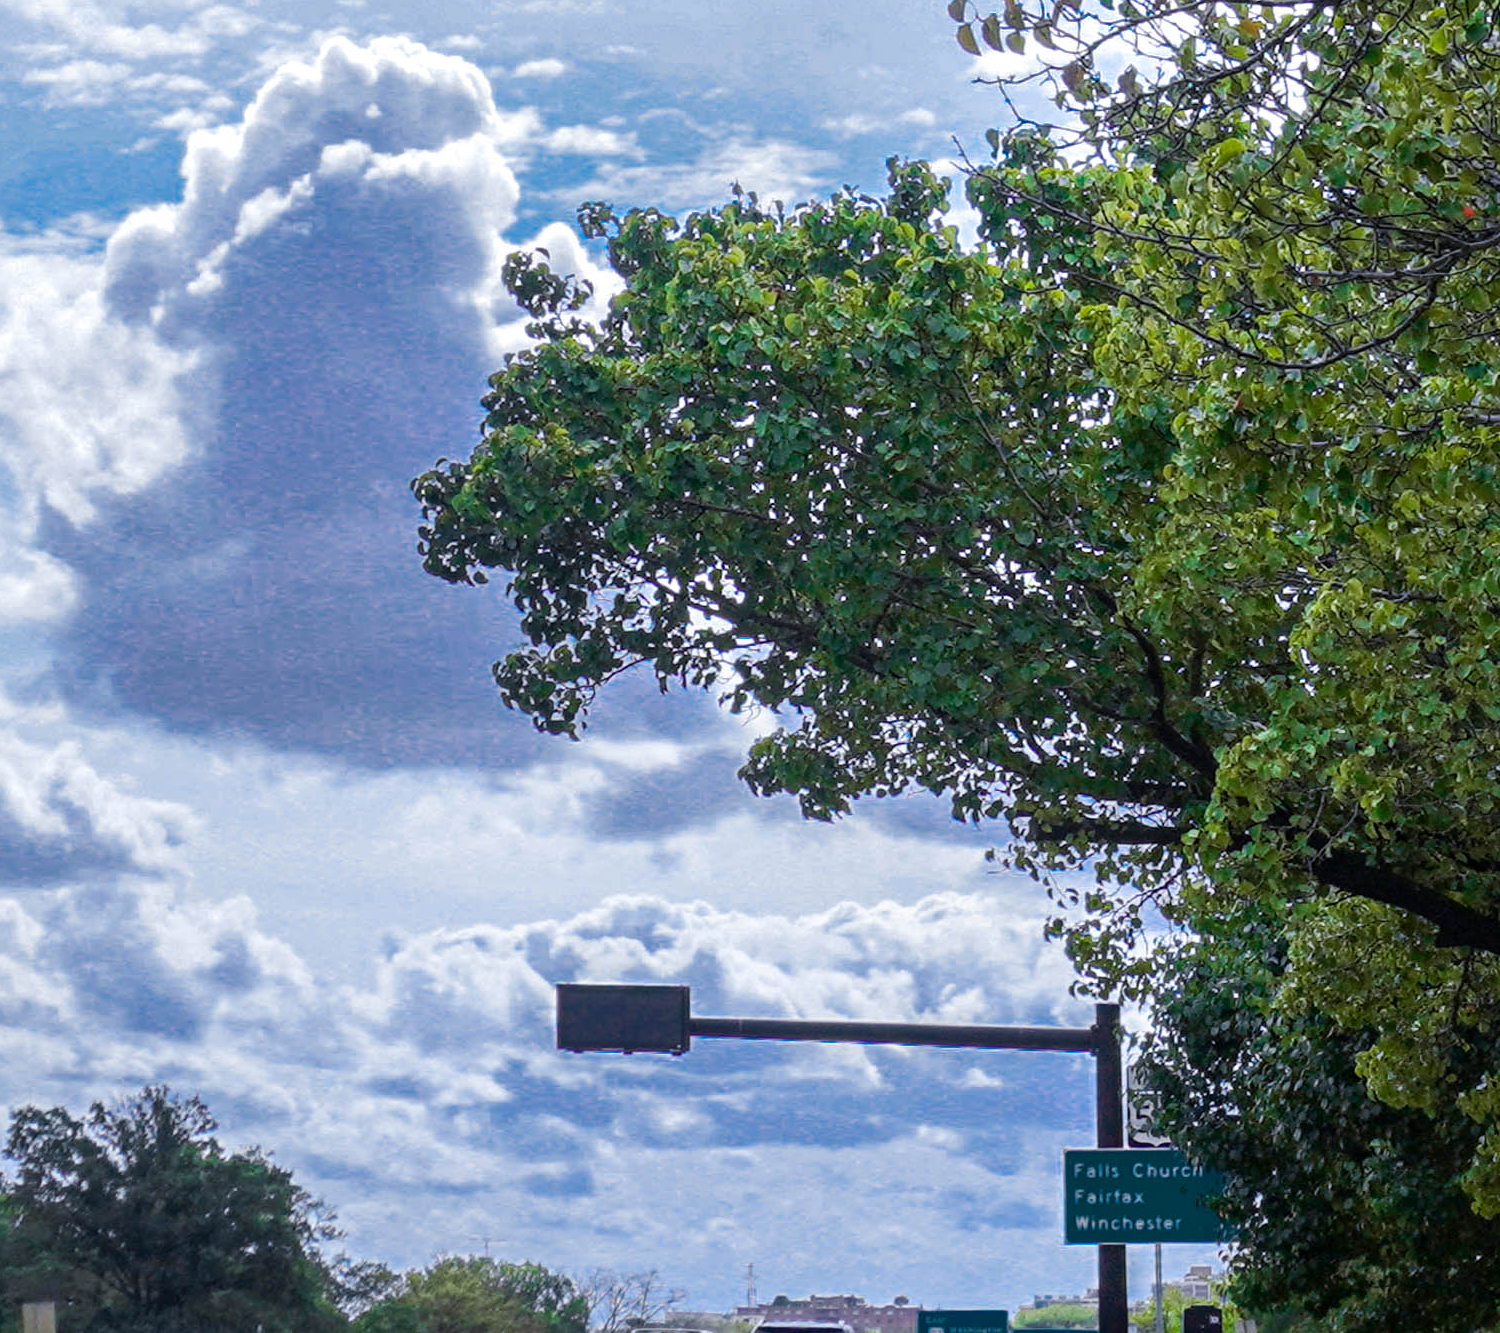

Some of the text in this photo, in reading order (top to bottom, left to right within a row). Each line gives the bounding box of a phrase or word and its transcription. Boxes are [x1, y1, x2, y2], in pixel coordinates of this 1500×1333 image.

[1073, 1162, 1204, 1178] Falls Church
[1074, 1189, 1145, 1204] Fairfax
[1075, 1215, 1182, 1231] Winchester
